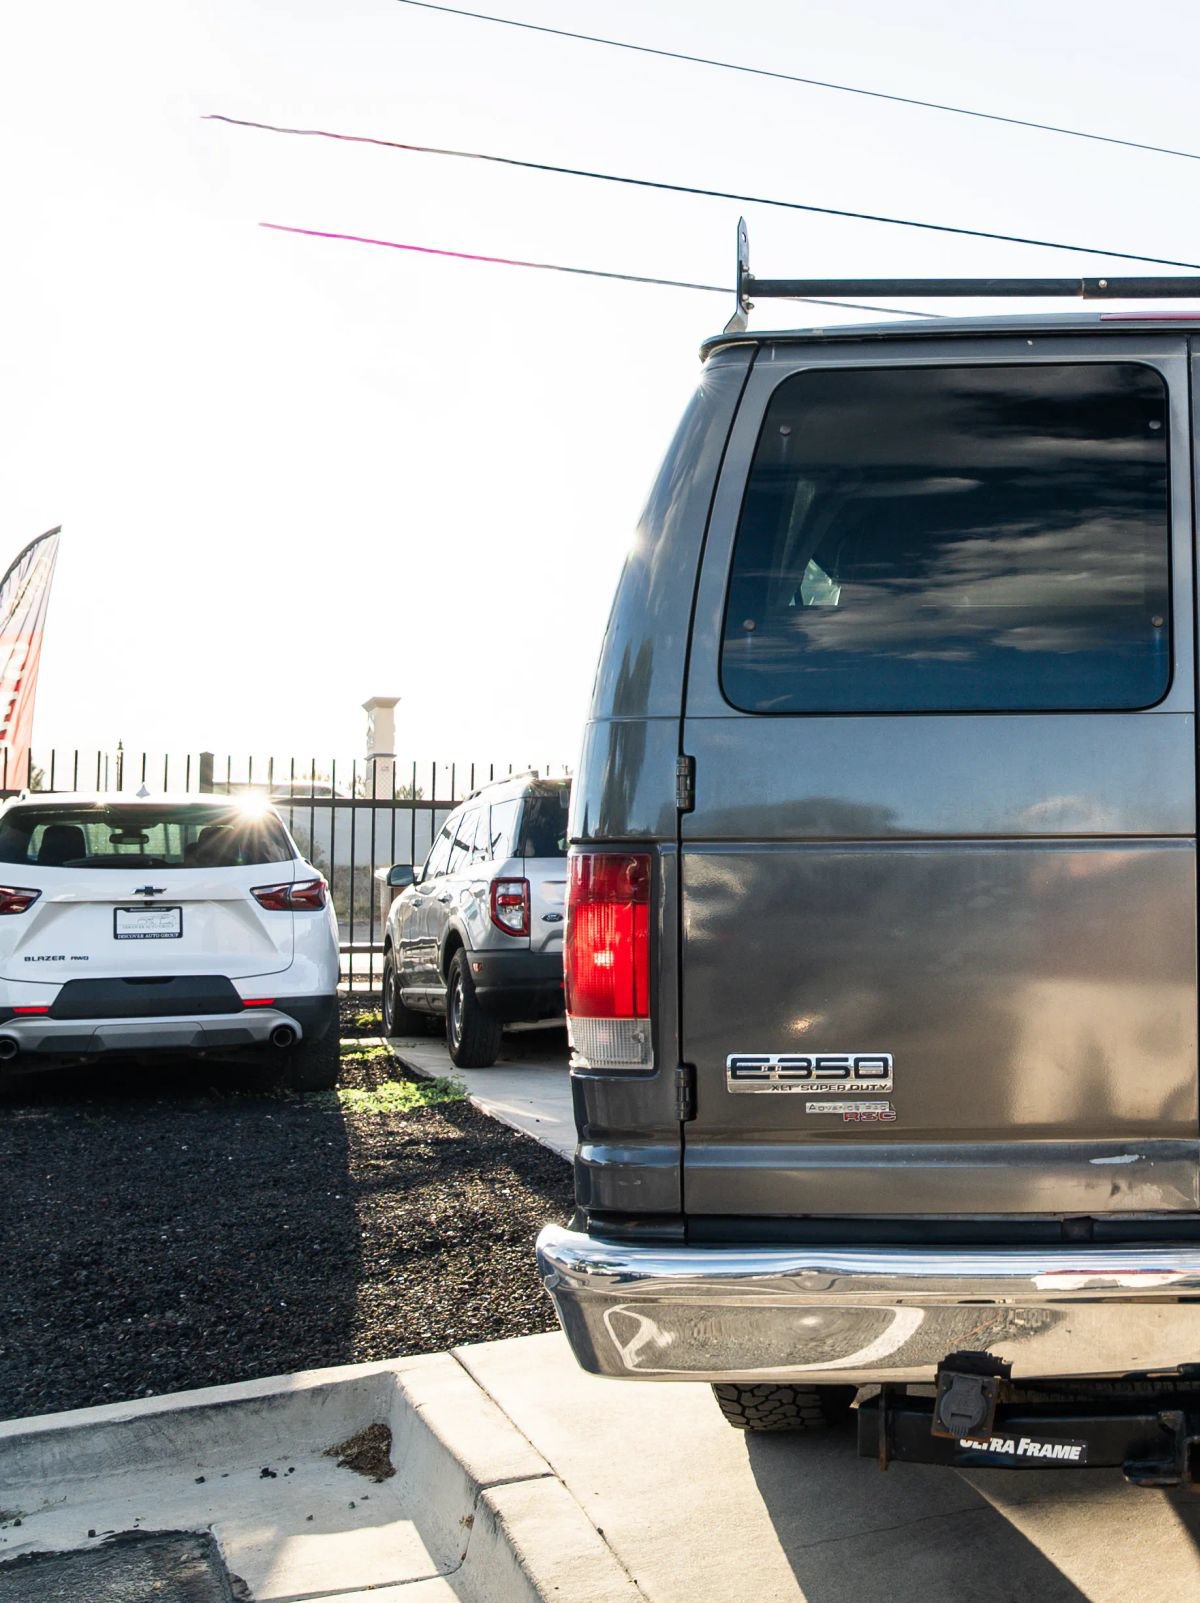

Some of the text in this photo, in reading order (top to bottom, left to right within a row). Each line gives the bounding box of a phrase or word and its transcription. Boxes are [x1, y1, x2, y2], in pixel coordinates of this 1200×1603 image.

[771, 1083, 888, 1092] XLT SUPER DUTY
[843, 1111, 897, 1122] RSC
[1016, 1437, 1082, 1460] FRAME
